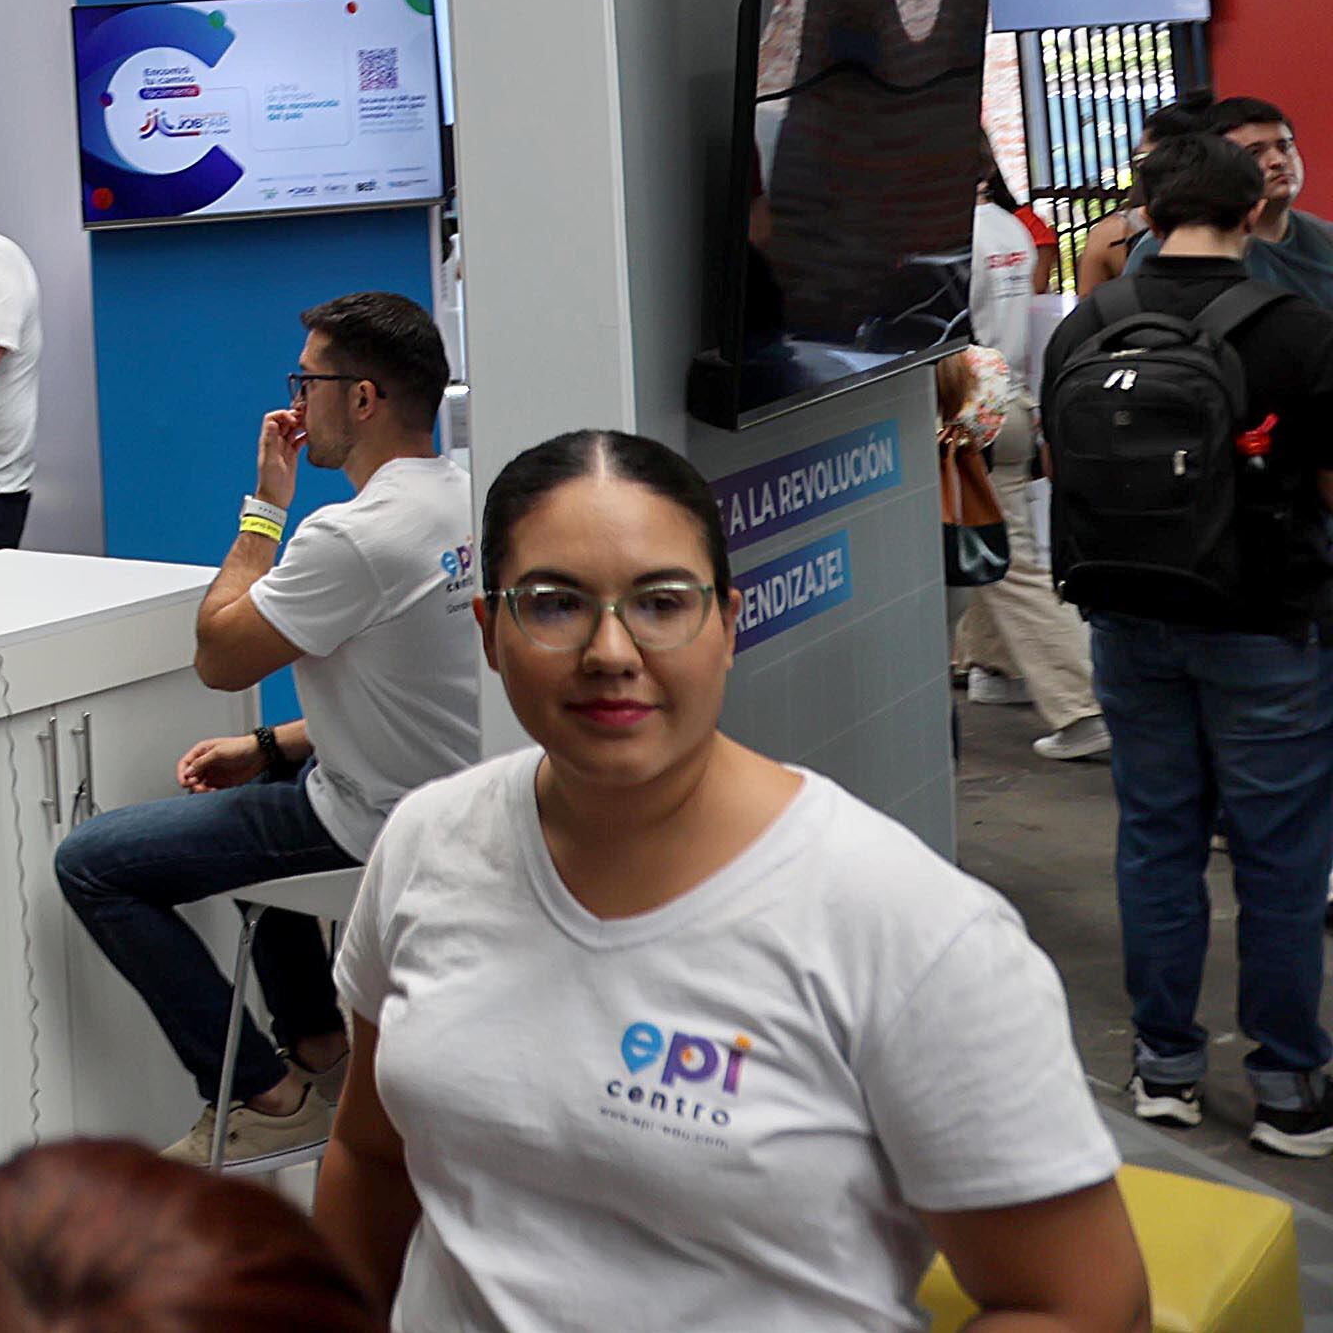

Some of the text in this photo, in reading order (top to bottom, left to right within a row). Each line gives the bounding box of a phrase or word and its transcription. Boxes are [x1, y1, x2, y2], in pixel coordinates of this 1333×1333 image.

[730, 493, 747, 536] A
[749, 482, 776, 527] LA
[779, 432, 894, 516] REVOLUCIÓN
[621, 1021, 752, 1095] epi
[607, 1080, 730, 1126] centro
